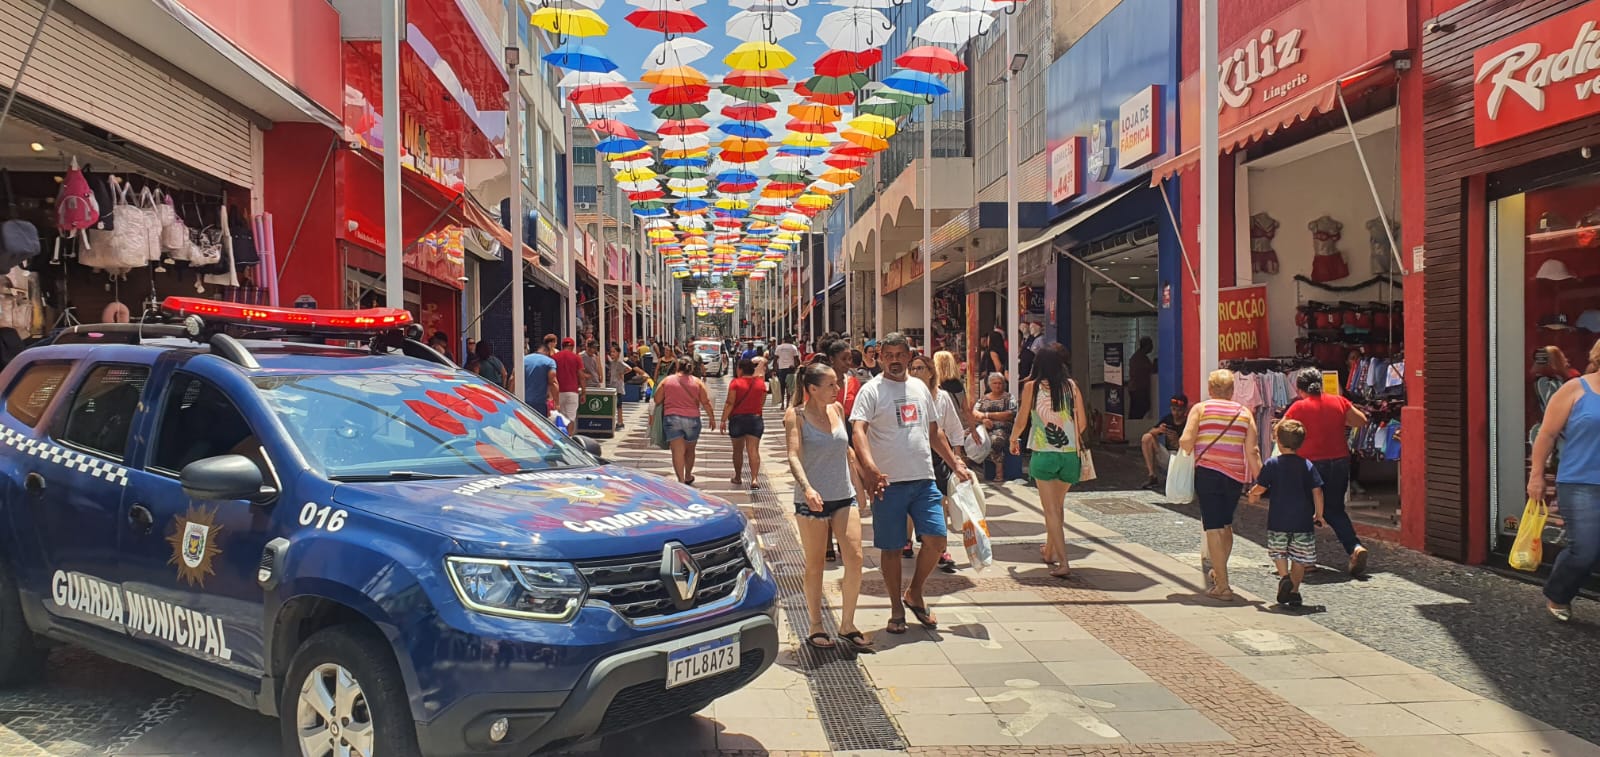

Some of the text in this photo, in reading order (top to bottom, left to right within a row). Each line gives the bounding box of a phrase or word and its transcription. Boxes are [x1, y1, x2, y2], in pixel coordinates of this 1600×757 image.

[1263, 73, 1308, 102] Lingerie
[1121, 104, 1149, 133] LOJA DE
[1120, 125, 1150, 152] FÁBRICA
[1218, 293, 1265, 324] RICAÇÃO
[1218, 328, 1258, 352] RÓPRIA
[452, 475, 522, 496] GUARDA
[298, 501, 348, 532] 016
[562, 503, 715, 533] CAMPINAS
[52, 569, 232, 660] GUARDA MUNICIPAL
[675, 646, 734, 682] FTL8A73
